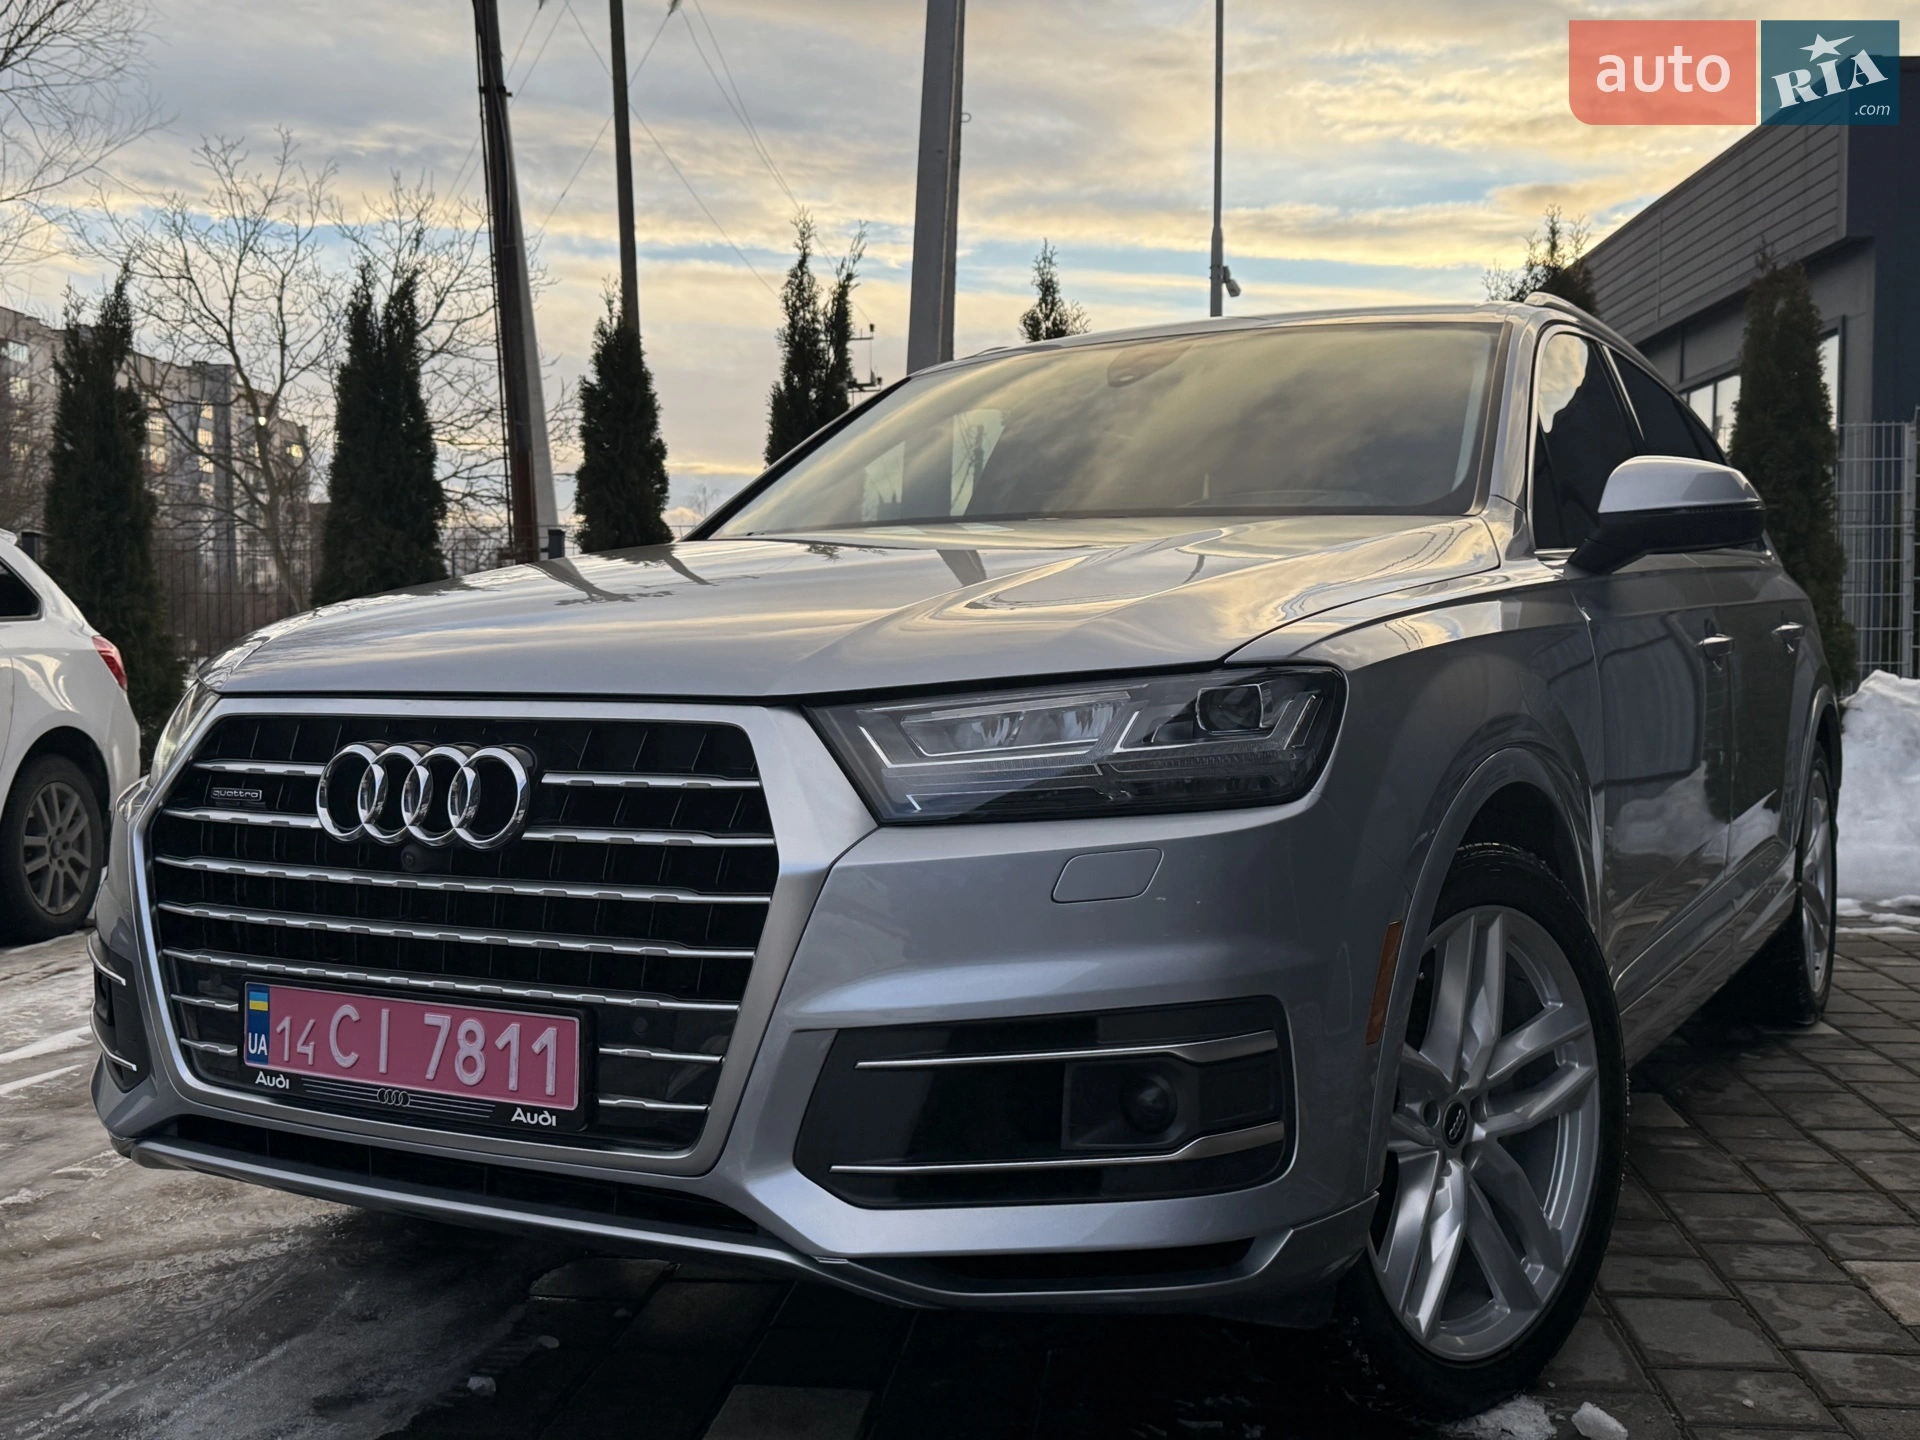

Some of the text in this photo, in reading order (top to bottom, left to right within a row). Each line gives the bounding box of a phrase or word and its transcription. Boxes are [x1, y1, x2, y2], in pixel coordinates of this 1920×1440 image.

[212, 790, 259, 798] quattro
[248, 1032, 268, 1056] UA
[424, 1013, 558, 1096] 7811
[255, 1071, 290, 1090] Audi
[511, 1107, 557, 1127] Audi
